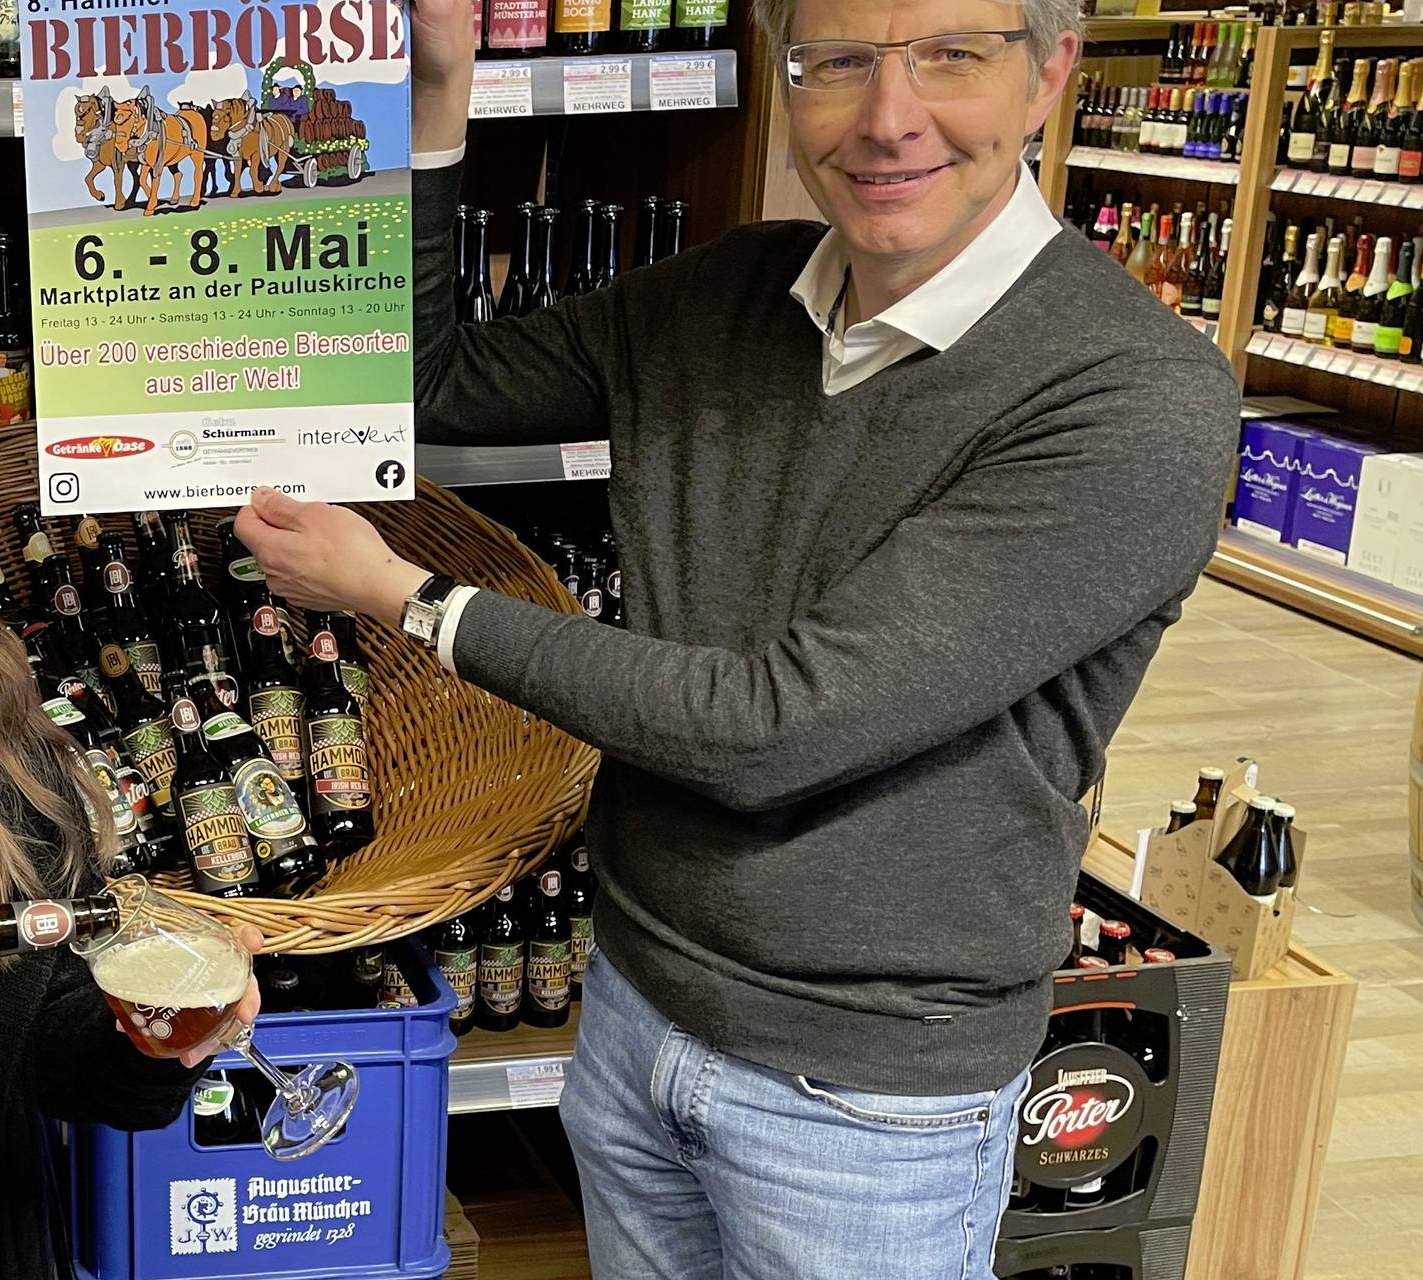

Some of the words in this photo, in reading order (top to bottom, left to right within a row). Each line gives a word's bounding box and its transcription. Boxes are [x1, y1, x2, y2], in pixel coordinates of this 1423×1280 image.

[563, 6, 595, 18] BOCK
[632, 9, 663, 18] HANF
[685, 6, 717, 16] HANF
[28, 0, 405, 80] BIERBÖRSE
[601, 65, 621, 74] 2,99
[621, 64, 627, 72] €
[686, 61, 705, 70] 2,99
[707, 60, 713, 69] €
[501, 70, 521, 79] 2,99
[523, 68, 529, 76] €
[573, 101, 625, 111] MEHRWEG
[659, 97, 710, 107] MEHRWEG
[475, 106, 527, 116] MEHRWEG
[75, 235, 123, 280] 6.
[190, 230, 238, 276] 8.
[266, 221, 368, 272] Mai
[41, 285, 161, 307] Marktplatz
[169, 285, 195, 300] an
[205, 280, 243, 297] der
[251, 272, 406, 296] Pauluskirche
[41, 318, 80, 330] Freitag
[85, 317, 97, 326] 13
[109, 316, 123, 325] 24
[127, 315, 147, 324] Uhr
[159, 312, 209, 322] Samstag
[213, 311, 226, 320] 13
[238, 310, 251, 320] 24
[255, 310, 276, 318] Uhr
[289, 306, 336, 318] Sonntag
[341, 305, 353, 314] 13
[365, 304, 380, 313] 20
[385, 303, 405, 312] Uhr
[41, 340, 91, 366] Über
[99, 342, 137, 363] 200
[145, 336, 287, 362] verschiedene
[297, 332, 407, 354] Biersorten
[147, 378, 183, 394] aus
[192, 370, 237, 392] aller
[245, 366, 299, 390] Welt!
[203, 428, 275, 438] Schürmann
[53, 442, 101, 455] Getränke
[1023, 1090, 1122, 1145] Porter
[1039, 1147, 1109, 1166] SCHWARZES
[247, 1174, 361, 1200] Augustiner-
[243, 1202, 290, 1224] Bräu
[293, 1200, 371, 1222] München
[253, 1224, 323, 1250] gegründet
[326, 1223, 355, 1246] 1328
